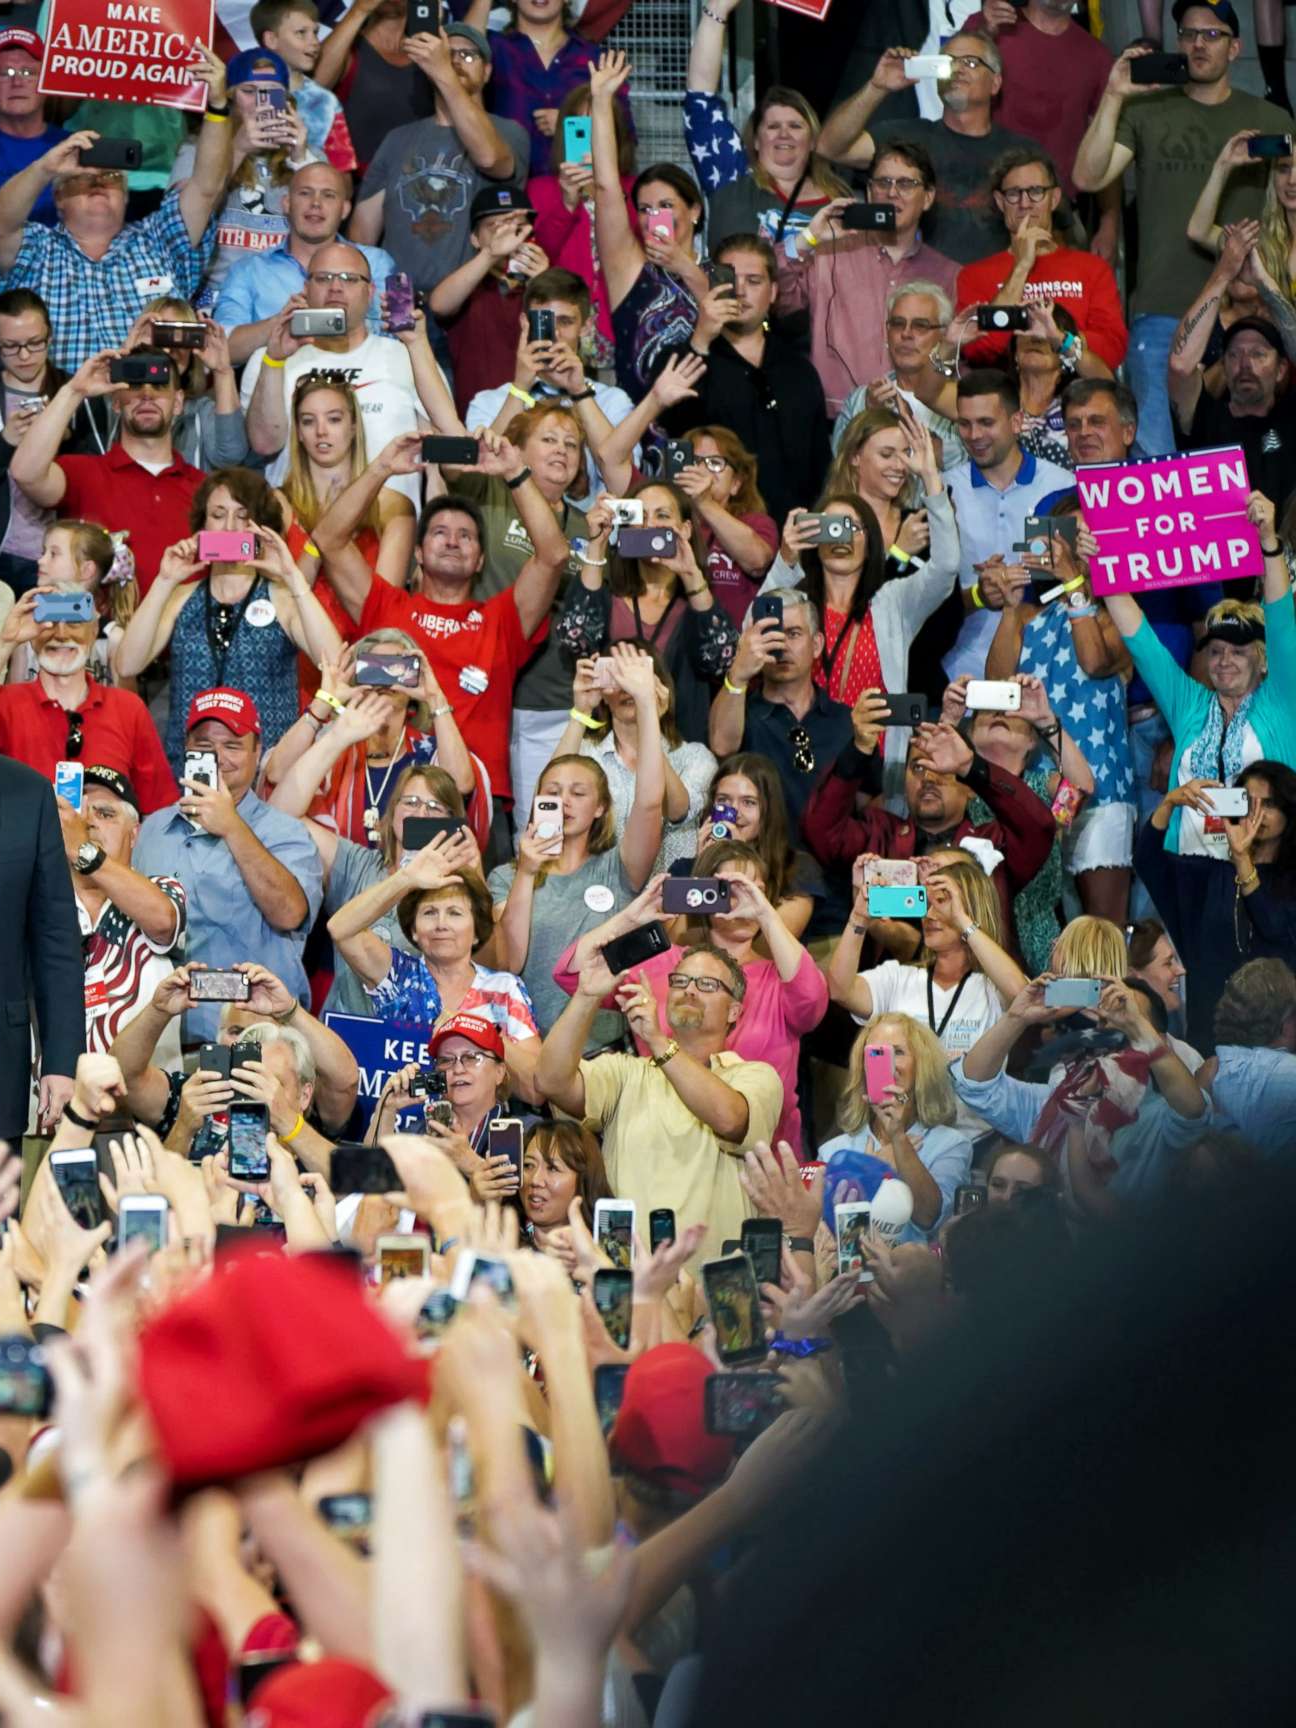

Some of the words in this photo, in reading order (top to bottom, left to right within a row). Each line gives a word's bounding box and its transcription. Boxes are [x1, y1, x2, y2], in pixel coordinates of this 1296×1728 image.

[108, 3, 161, 24] MAKE
[51, 23, 207, 62] AMERICA
[51, 54, 128, 79] PROUD
[1078, 461, 1247, 509] WOMEN
[1136, 512, 1196, 539] FOR
[1098, 538, 1250, 584] TRUMP
[196, 693, 214, 705] MAKE
[213, 692, 244, 708] AMERICA
[198, 700, 217, 712] GREAT
[218, 700, 242, 714] AGAIN
[1212, 835, 1226, 843] VIP
[384, 1039, 431, 1066] KEE
